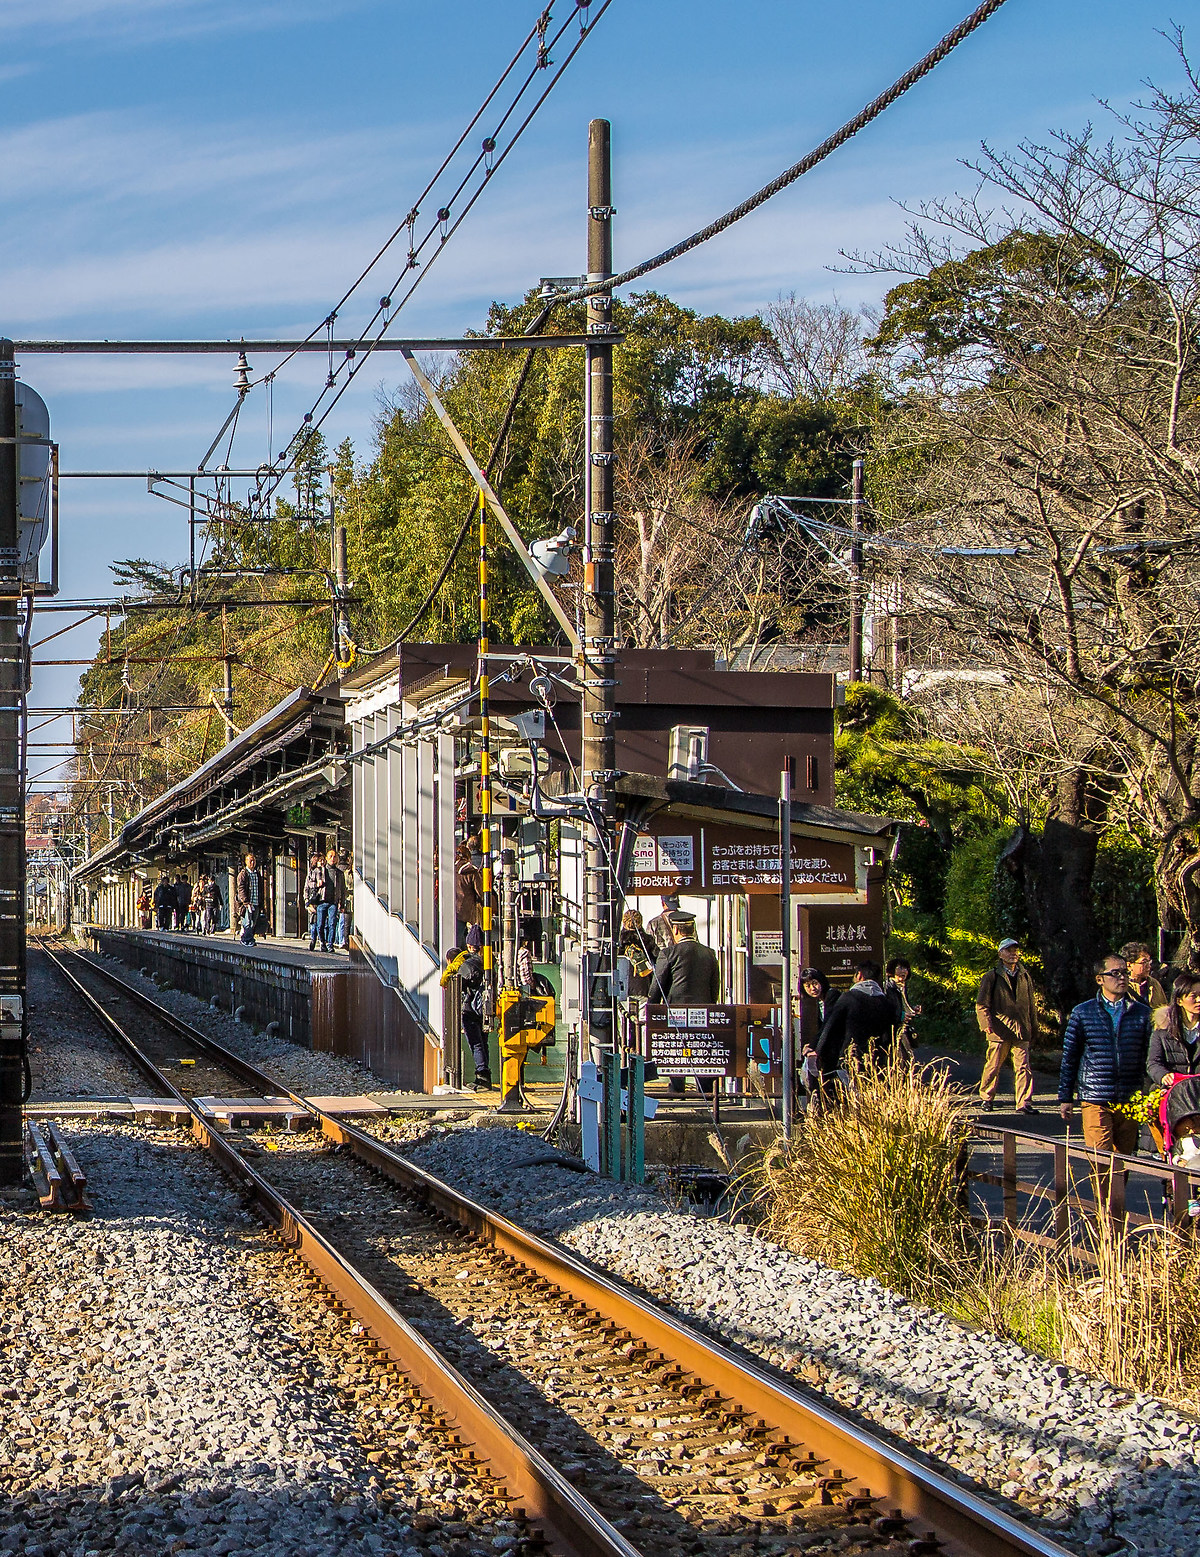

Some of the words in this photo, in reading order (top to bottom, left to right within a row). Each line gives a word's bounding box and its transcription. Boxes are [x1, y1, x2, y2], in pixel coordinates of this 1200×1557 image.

[712, 844, 797, 856] きっぷをお持ちでい
[712, 873, 847, 885] 西口できっぷをおい求めください
[826, 924, 867, 941] 北鎌倉駅
[855, 943, 873, 952] Station
